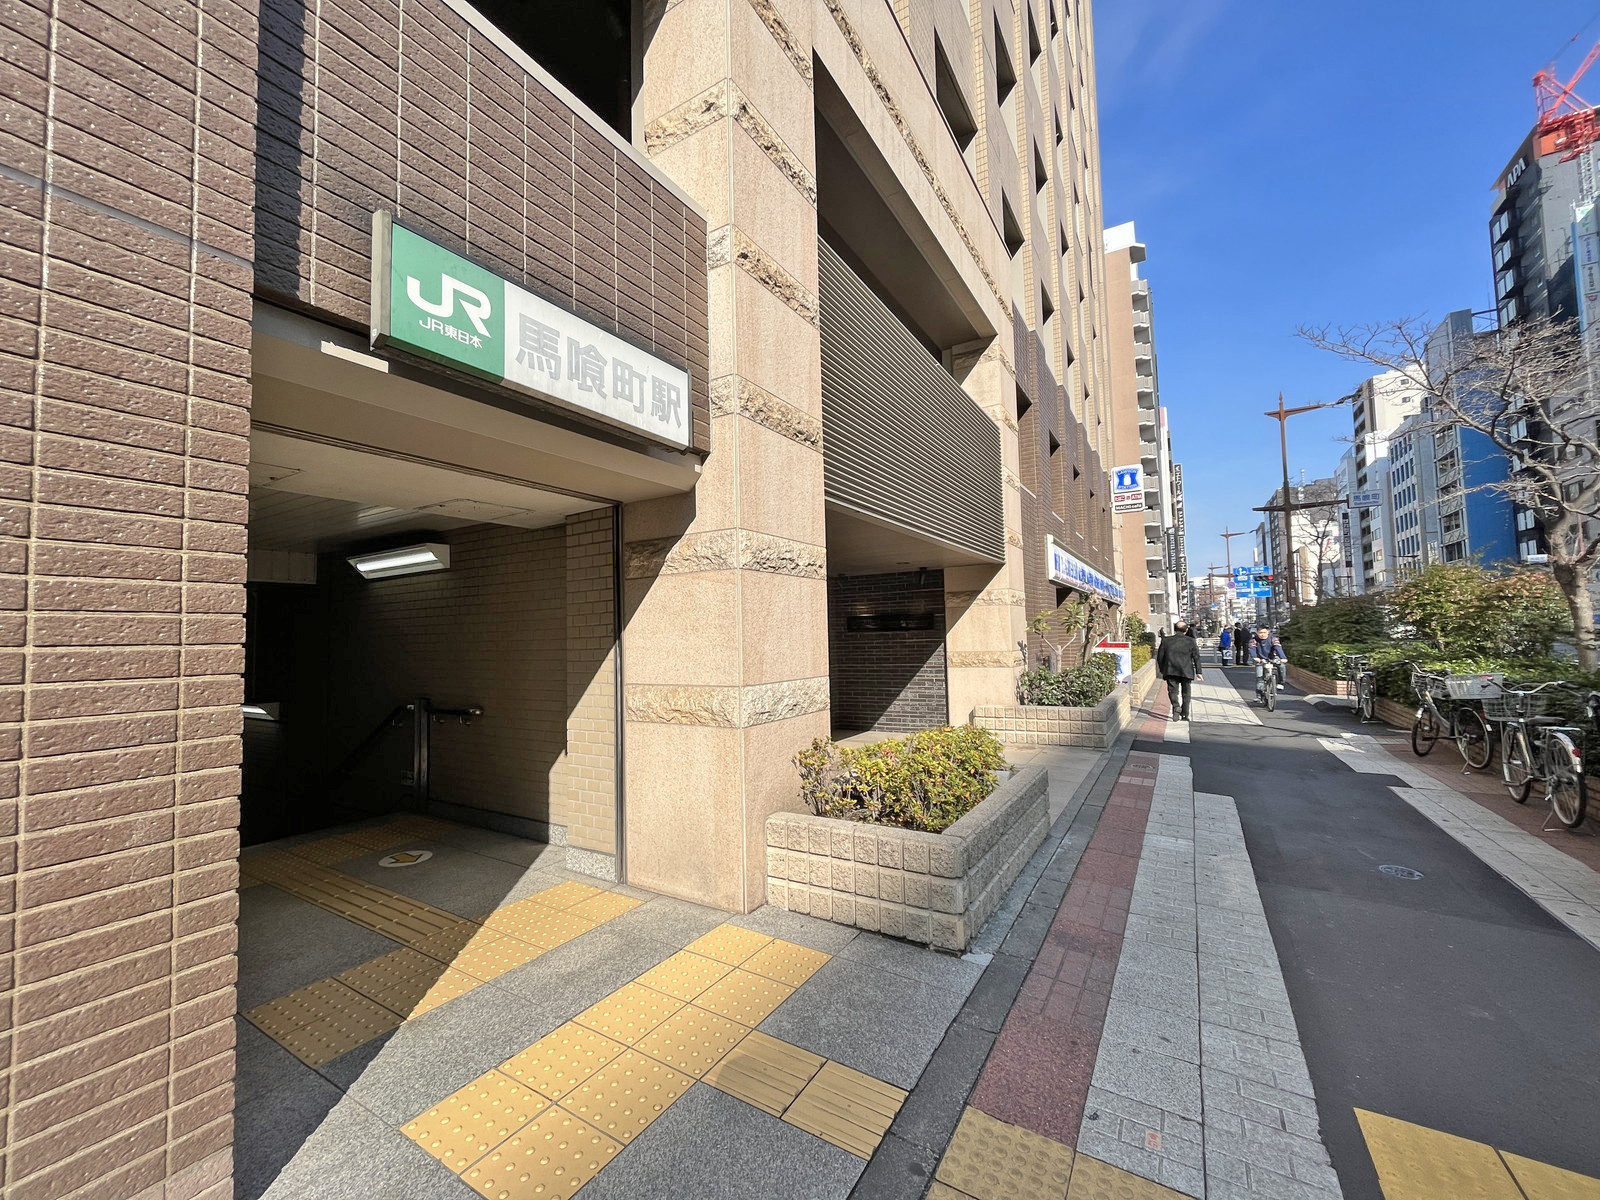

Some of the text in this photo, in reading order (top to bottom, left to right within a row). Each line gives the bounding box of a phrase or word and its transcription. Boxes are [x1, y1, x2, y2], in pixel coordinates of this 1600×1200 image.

[1506, 157, 1527, 188] APA
[406, 272, 492, 338] JR
[418, 315, 484, 349] JR東日本
[515, 312, 682, 429] 馬喰町駅
